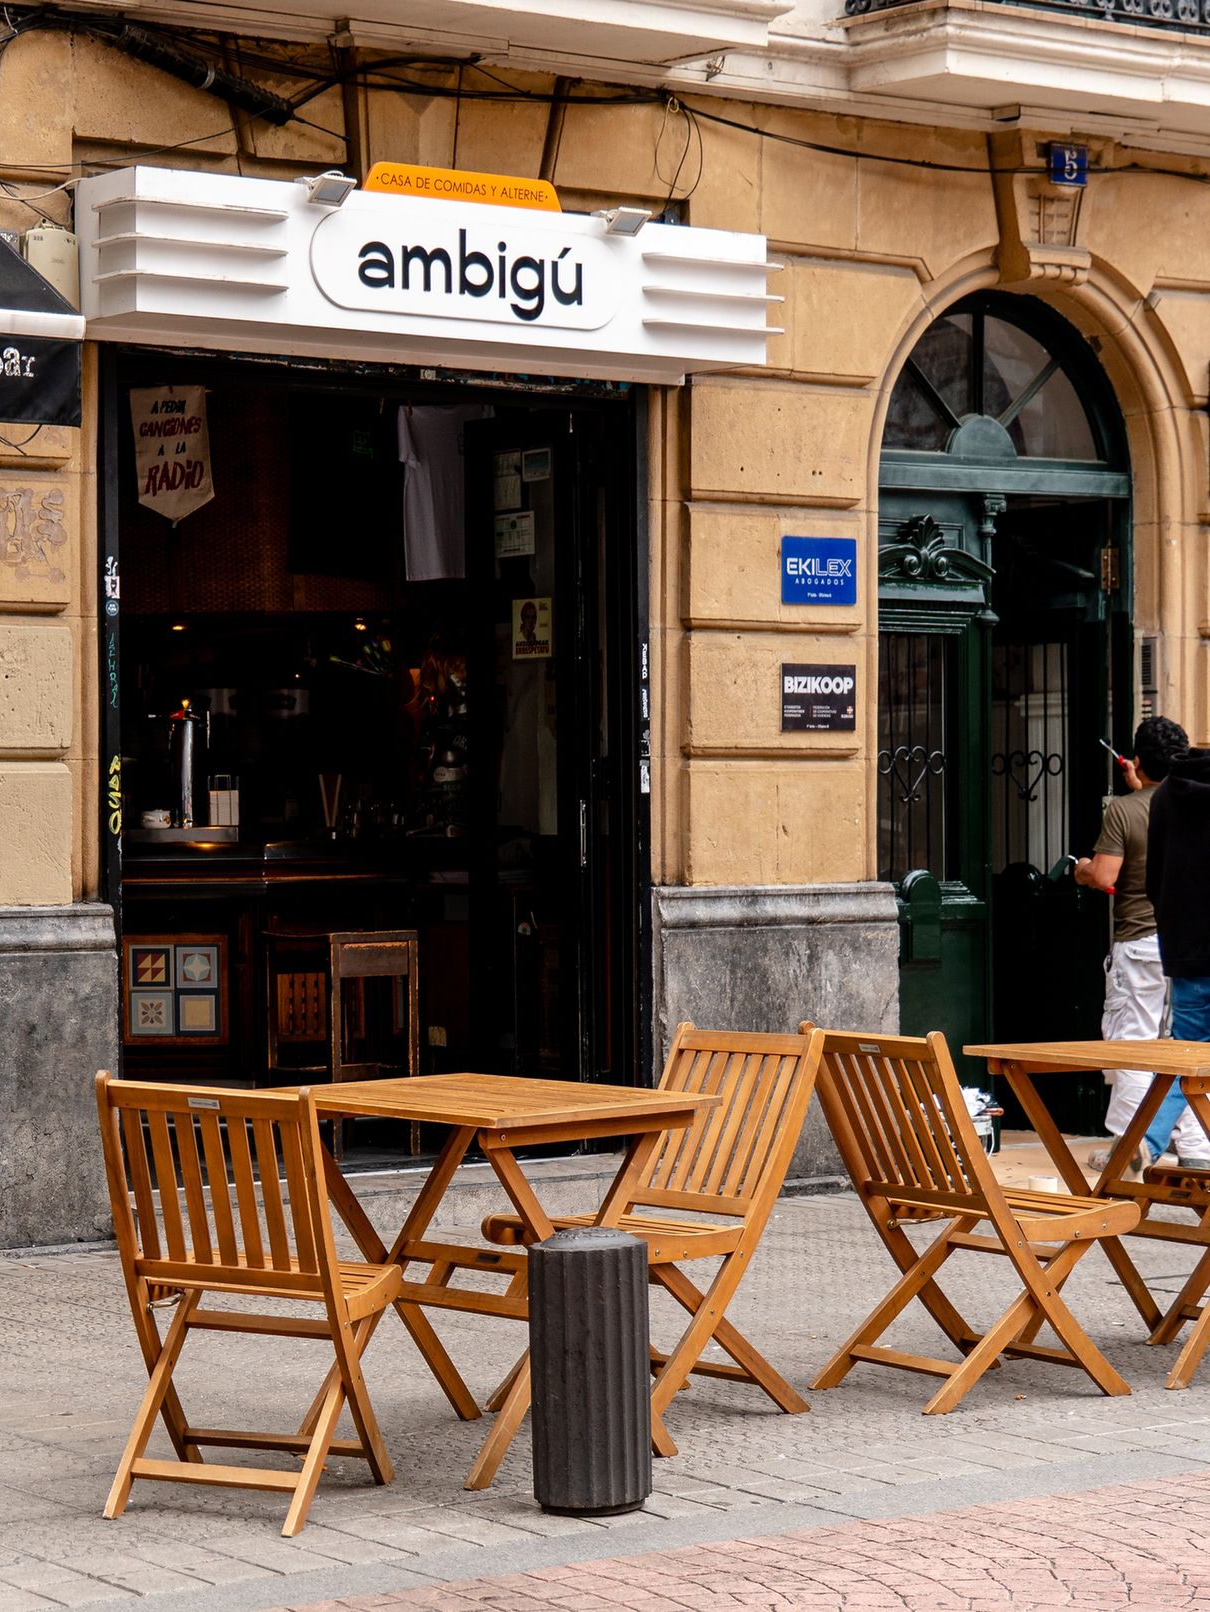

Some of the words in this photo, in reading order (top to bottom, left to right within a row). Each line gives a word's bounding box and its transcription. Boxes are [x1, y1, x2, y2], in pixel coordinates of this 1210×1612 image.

[1064, 149, 1078, 180] 5
[380, 172, 412, 188] CASA
[416, 176, 430, 189] DE
[433, 178, 487, 196] COMIDAS
[490, 186, 497, 197] Y
[500, 187, 544, 203] ALTERNE
[357, 228, 583, 321] ambigú
[157, 444, 165, 456] A
[175, 441, 186, 455] LA
[786, 557, 852, 577] EKILEX
[794, 578, 844, 586] ABOGADOS
[783, 676, 854, 694] BIZIKOOP
